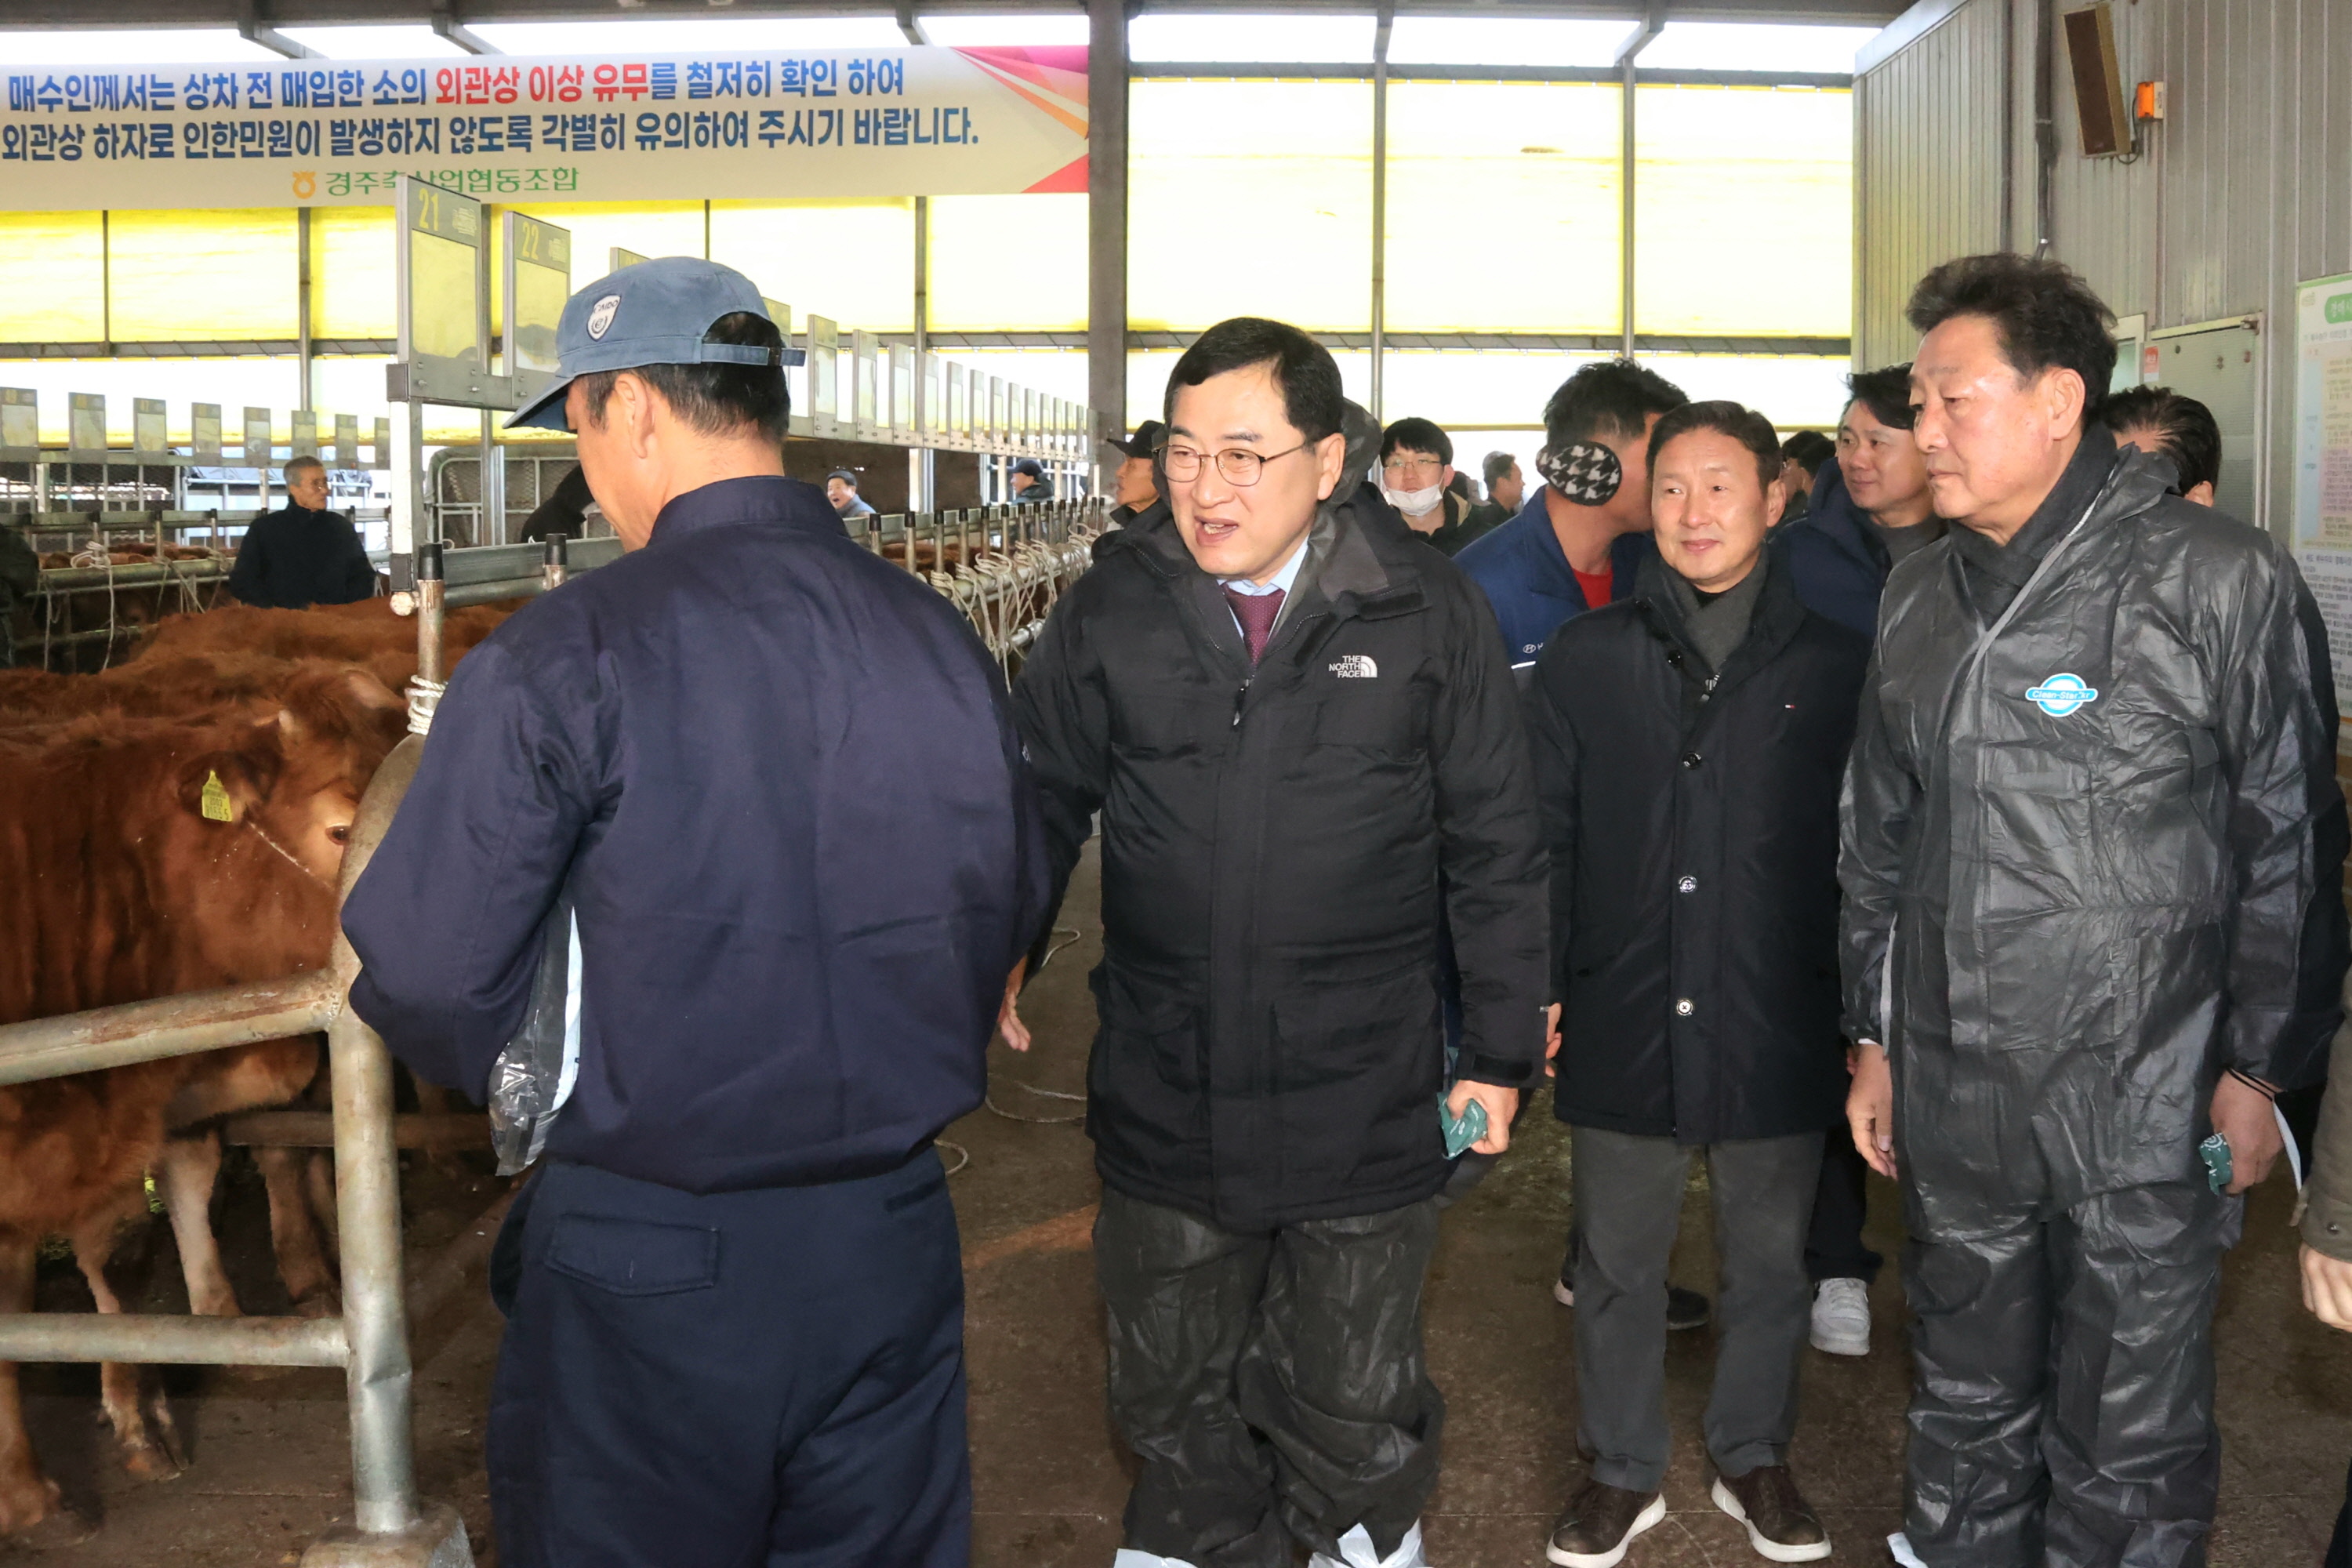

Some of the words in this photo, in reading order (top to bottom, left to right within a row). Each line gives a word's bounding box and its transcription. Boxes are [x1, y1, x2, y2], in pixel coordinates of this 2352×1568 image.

[9, 74, 175, 113] 매수인께서는
[183, 72, 238, 111] 상차
[247, 71, 273, 110] 전
[281, 69, 365, 108] 매입한
[372, 68, 426, 106] 소의
[436, 66, 521, 105] 외관상
[528, 64, 585, 103] 이상
[593, 62, 678, 102] 유무를
[687, 60, 771, 100] 철저히
[781, 59, 837, 97] 확인
[847, 58, 903, 96] 하여
[2, 123, 85, 162] 외관상
[93, 122, 175, 160] 하자로
[330, 117, 440, 157] 발생하지
[449, 114, 532, 154] 않도록
[542, 112, 626, 152] 각별히
[634, 111, 749, 151] 유의하여
[757, 108, 844, 148] 주시기
[854, 107, 978, 146] 바랍니다.
[419, 187, 439, 232] 21
[521, 220, 539, 260] 22
[1328, 662, 1360, 671] NORTH
[1337, 670, 1361, 678] FACE
